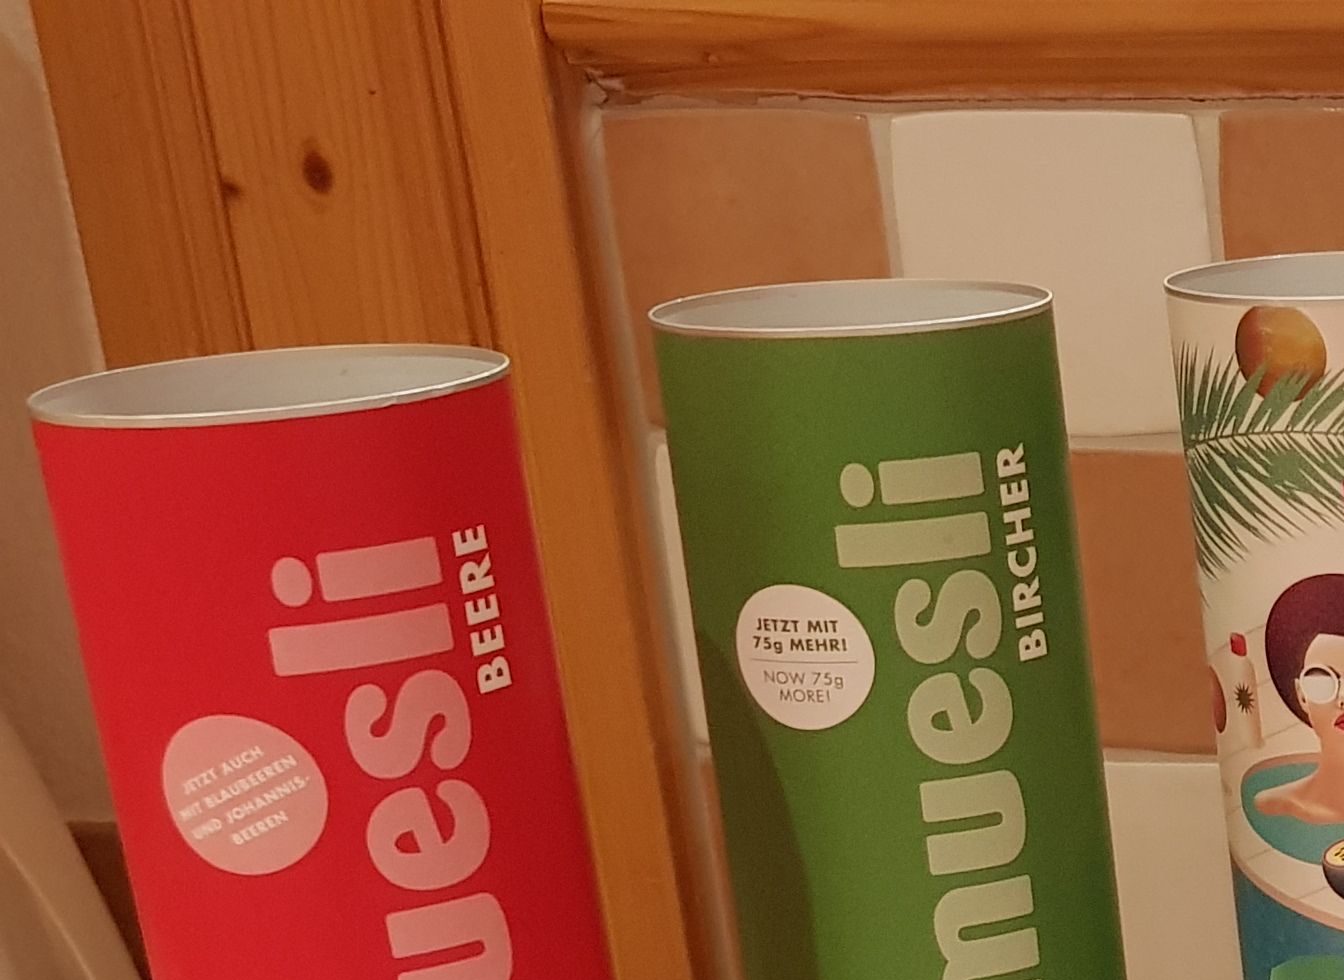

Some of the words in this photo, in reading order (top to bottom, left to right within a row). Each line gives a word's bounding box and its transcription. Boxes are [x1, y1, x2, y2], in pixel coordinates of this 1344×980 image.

[997, 443, 1048, 662] BIRCHER
[451, 523, 513, 695] BEERE
[756, 618, 799, 632] JETZT
[807, 620, 838, 634] MIT
[752, 636, 783, 654] 75g
[790, 638, 848, 652] MEHR!
[763, 670, 806, 685] NOW
[813, 672, 844, 689] 75g
[779, 689, 830, 703] MORE!
[221, 745, 264, 776] AUCH
[204, 755, 298, 809] BLAUBEEREN
[231, 810, 289, 846] BEEREN
